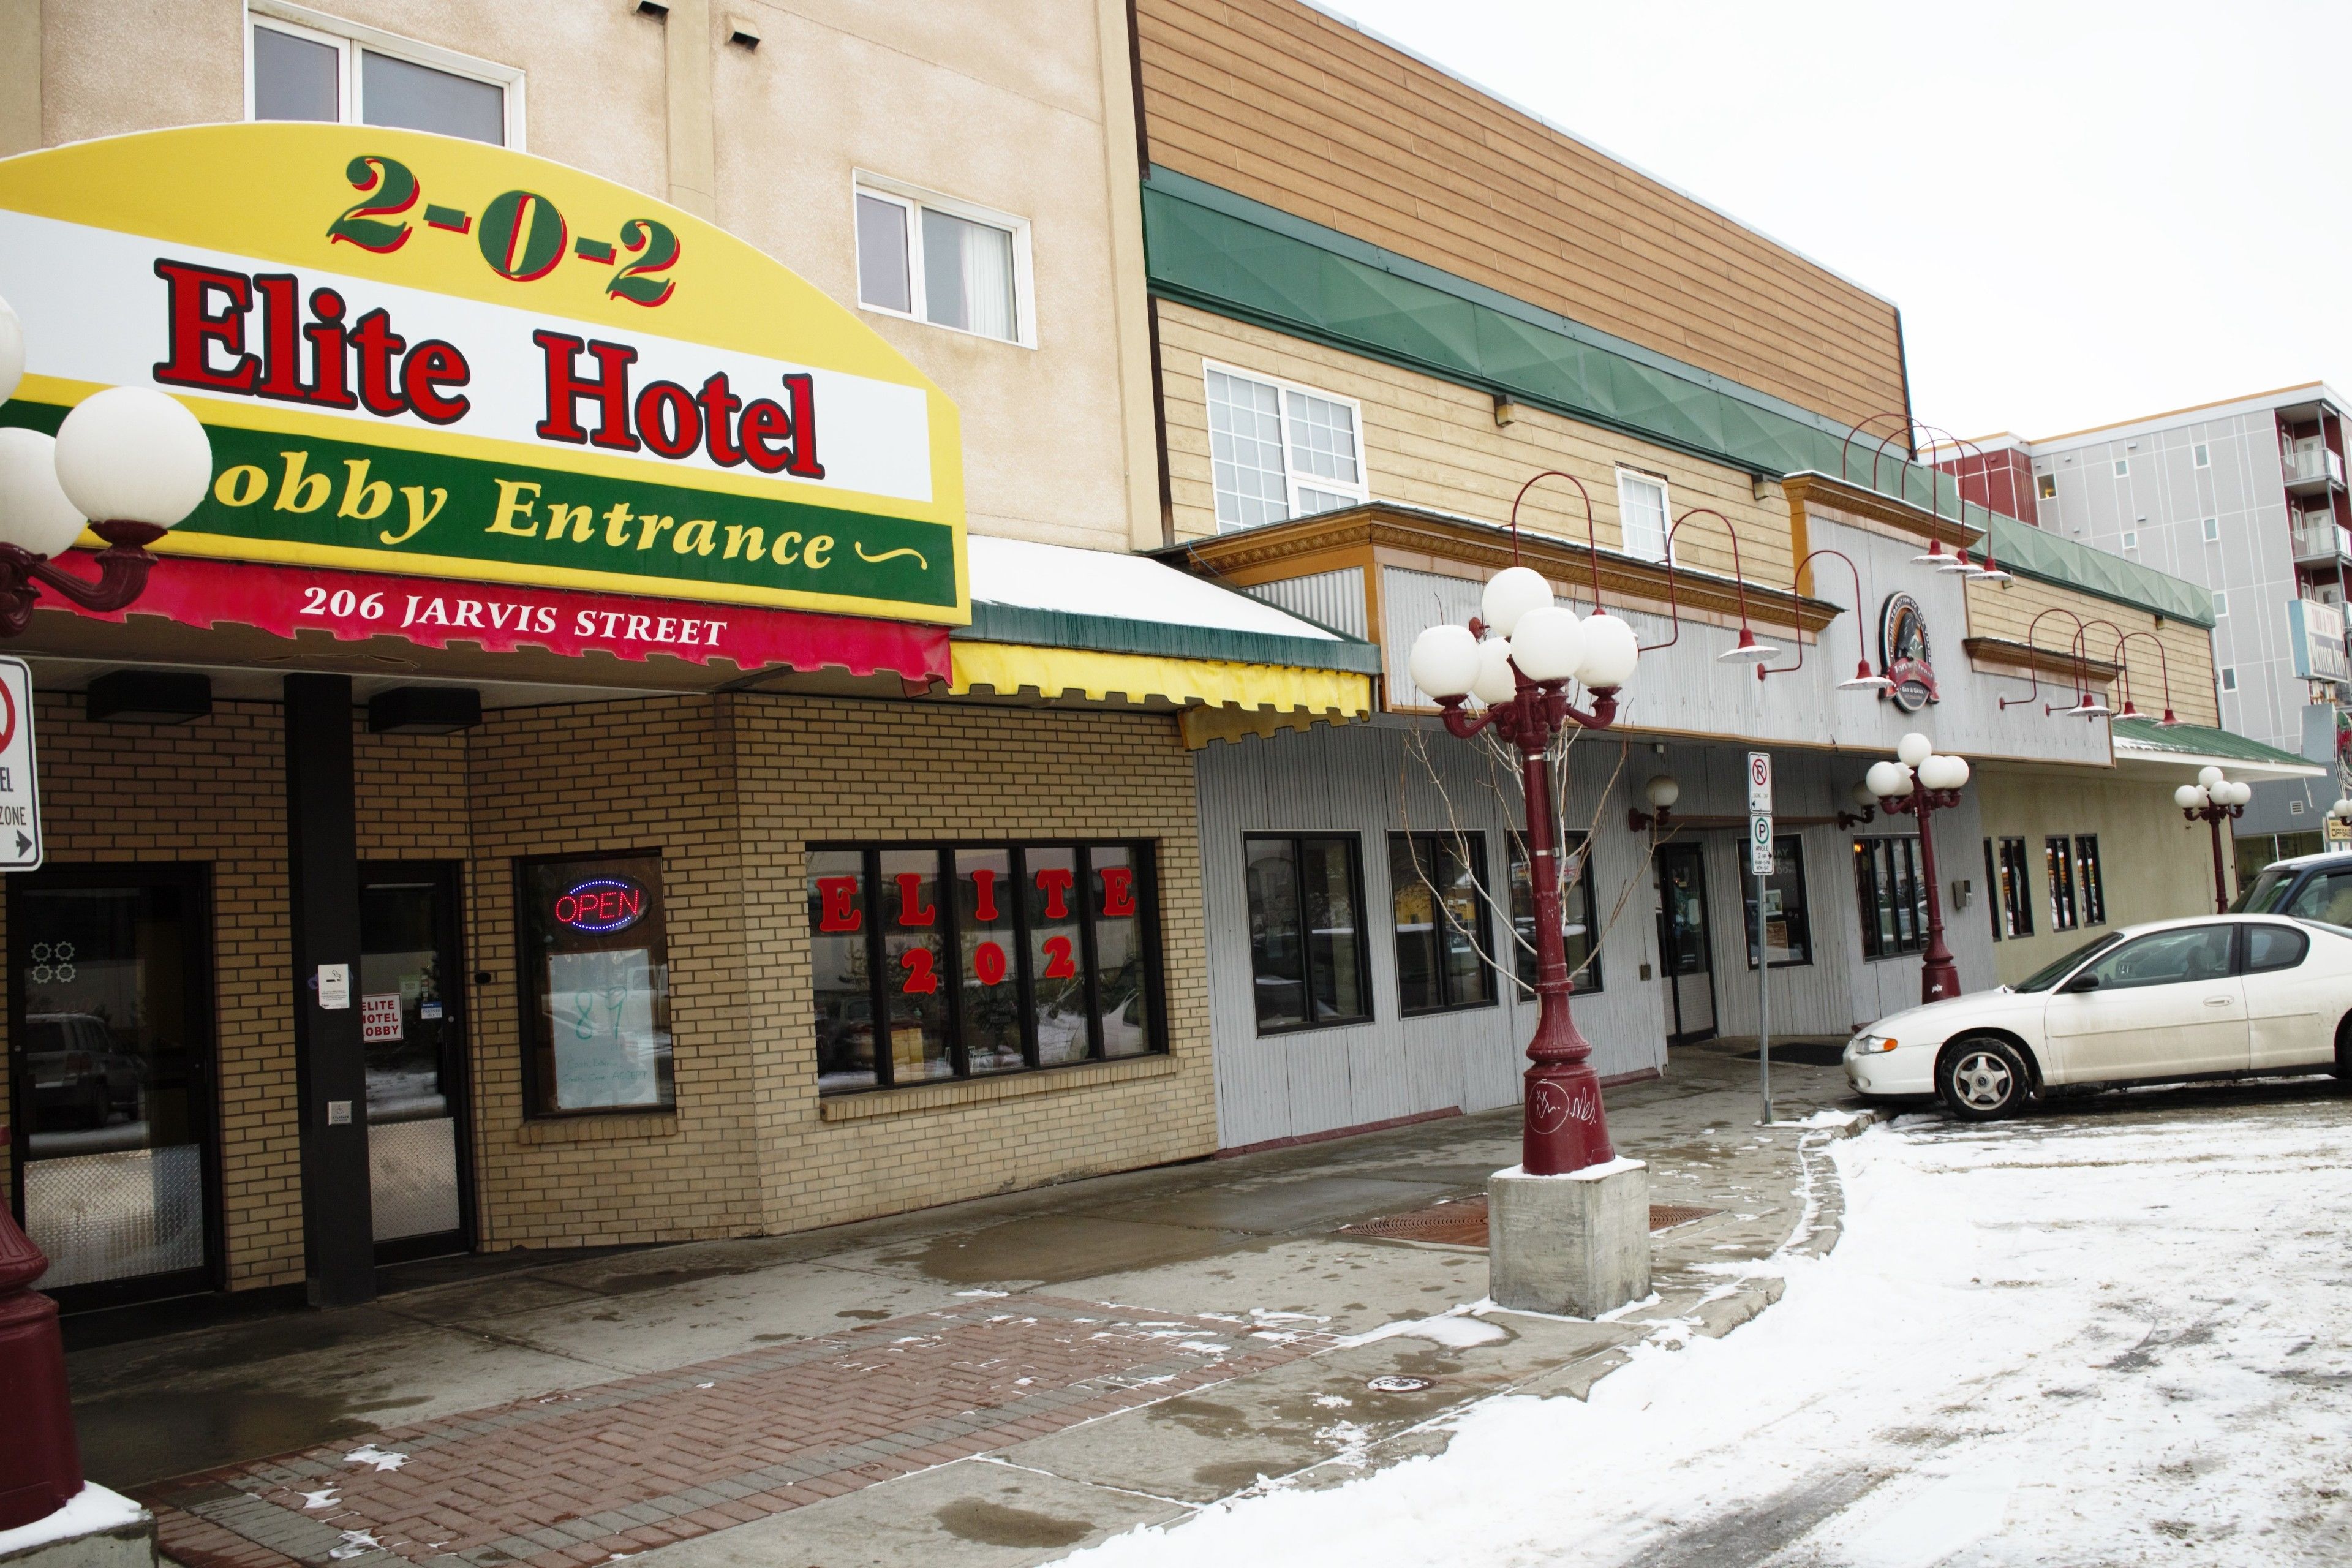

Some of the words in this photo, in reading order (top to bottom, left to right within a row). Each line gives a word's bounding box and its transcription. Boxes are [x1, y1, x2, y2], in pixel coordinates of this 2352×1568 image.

[326, 156, 680, 307] 2-0-2
[153, 258, 470, 425] Elite
[533, 329, 825, 480] Hotel
[214, 451, 448, 545] obby
[485, 479, 834, 569] Entrance
[300, 587, 385, 620] 206
[400, 595, 557, 633] JARVIS
[575, 609, 728, 647] STREET
[0, 805, 26, 826] ZONE
[555, 889, 640, 922] OPEN
[815, 868, 1136, 932] ELITE
[901, 936, 1076, 995] 202
[362, 1000, 394, 1011] ELITE
[363, 1025, 399, 1037] OBBY
